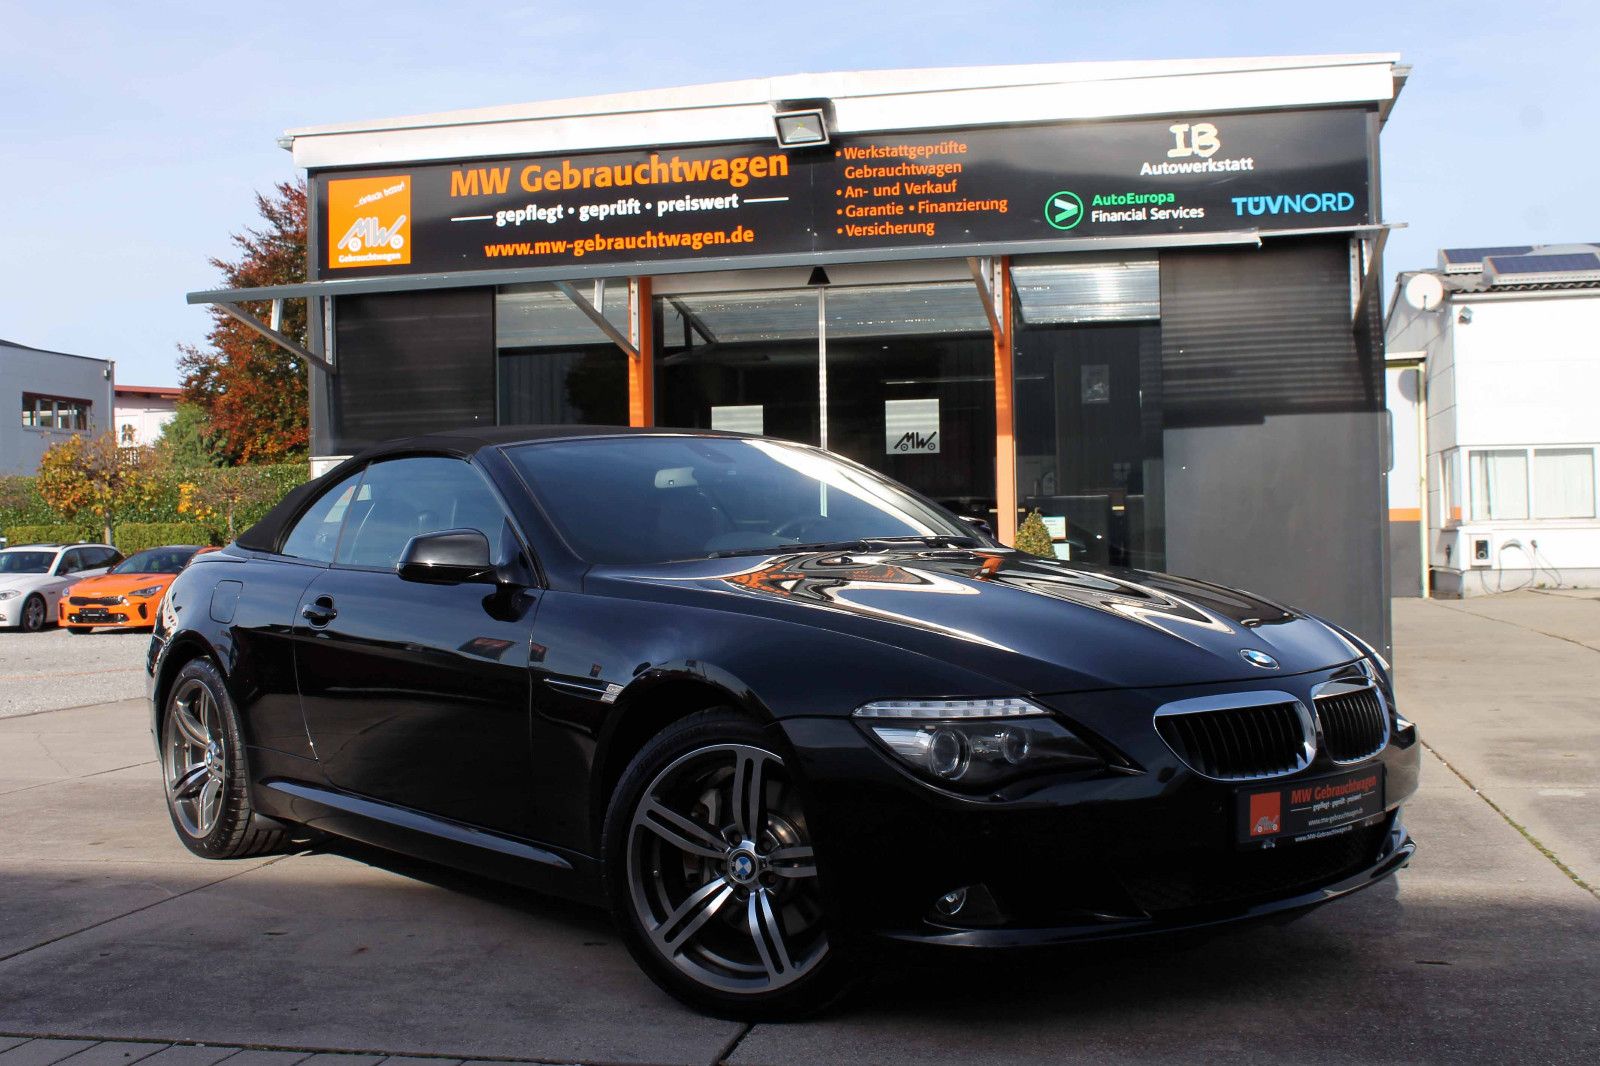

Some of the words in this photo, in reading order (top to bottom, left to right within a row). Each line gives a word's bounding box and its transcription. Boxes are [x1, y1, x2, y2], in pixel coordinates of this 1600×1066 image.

[844, 140, 968, 160] Werkstattgeprüfte
[1167, 123, 1221, 158] IB
[450, 167, 511, 198] MW
[520, 154, 789, 192] Gebrauchtwagen
[844, 162, 962, 180] Gebrauchtwagen
[1139, 157, 1254, 176] Autowerkstatt
[845, 185, 869, 199] An-
[873, 182, 901, 197] und
[904, 179, 958, 195] Verkauf
[1092, 191, 1176, 206] AutoEuropa
[495, 203, 564, 227] gepflegt
[579, 197, 641, 222] geprüft
[657, 193, 740, 218] preiswert
[845, 202, 904, 218] Garantie
[917, 198, 1009, 214] Finanzierung
[1091, 207, 1147, 222] Financial
[1150, 205, 1205, 220] Services
[338, 214, 407, 251] MW
[845, 222, 936, 237] Versicherung
[484, 226, 755, 258] www.mw-gebrauchtwagen.de
[893, 431, 937, 451] MW
[1290, 787, 1313, 804] MW
